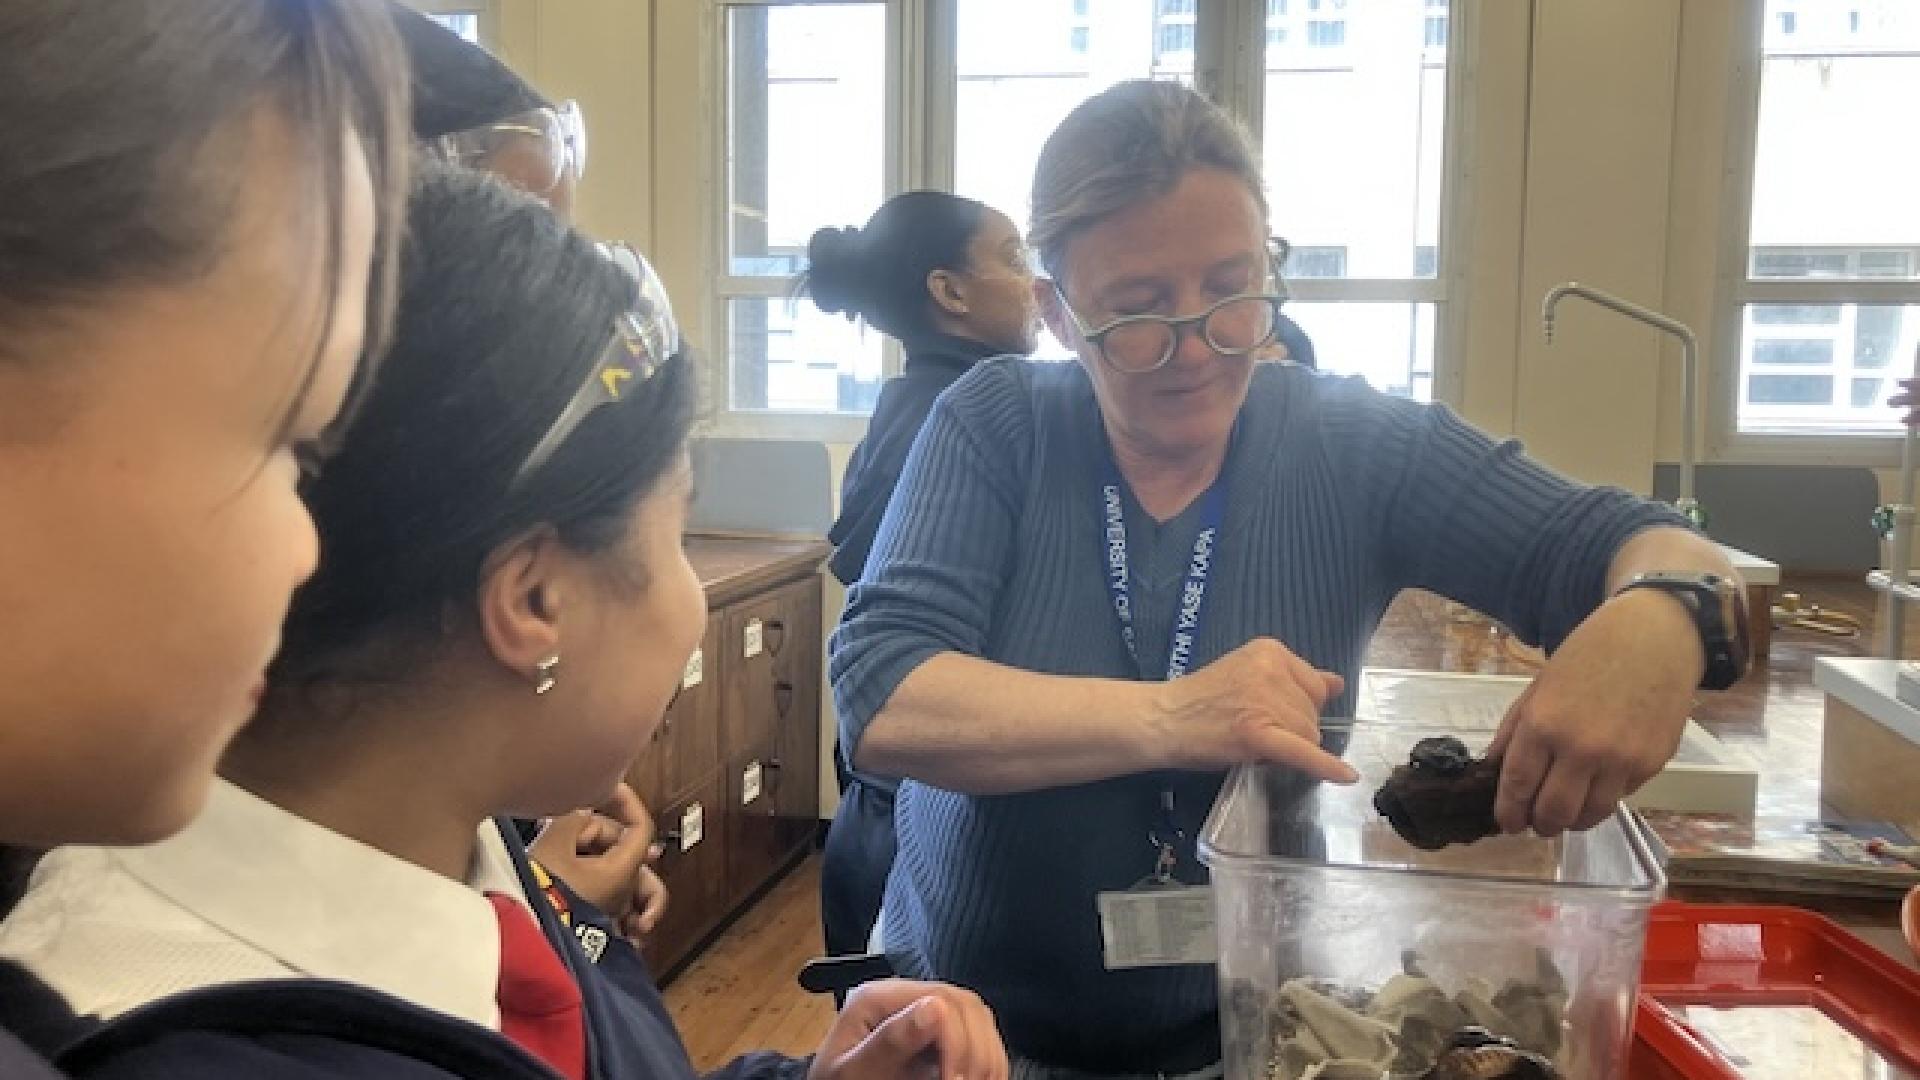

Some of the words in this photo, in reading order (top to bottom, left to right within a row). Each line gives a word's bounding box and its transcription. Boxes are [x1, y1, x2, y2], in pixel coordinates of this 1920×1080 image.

[1103, 485, 1128, 591] UNIVERSITY
[1191, 527, 1216, 577] KAPA
[1180, 582, 1204, 628] YASE
